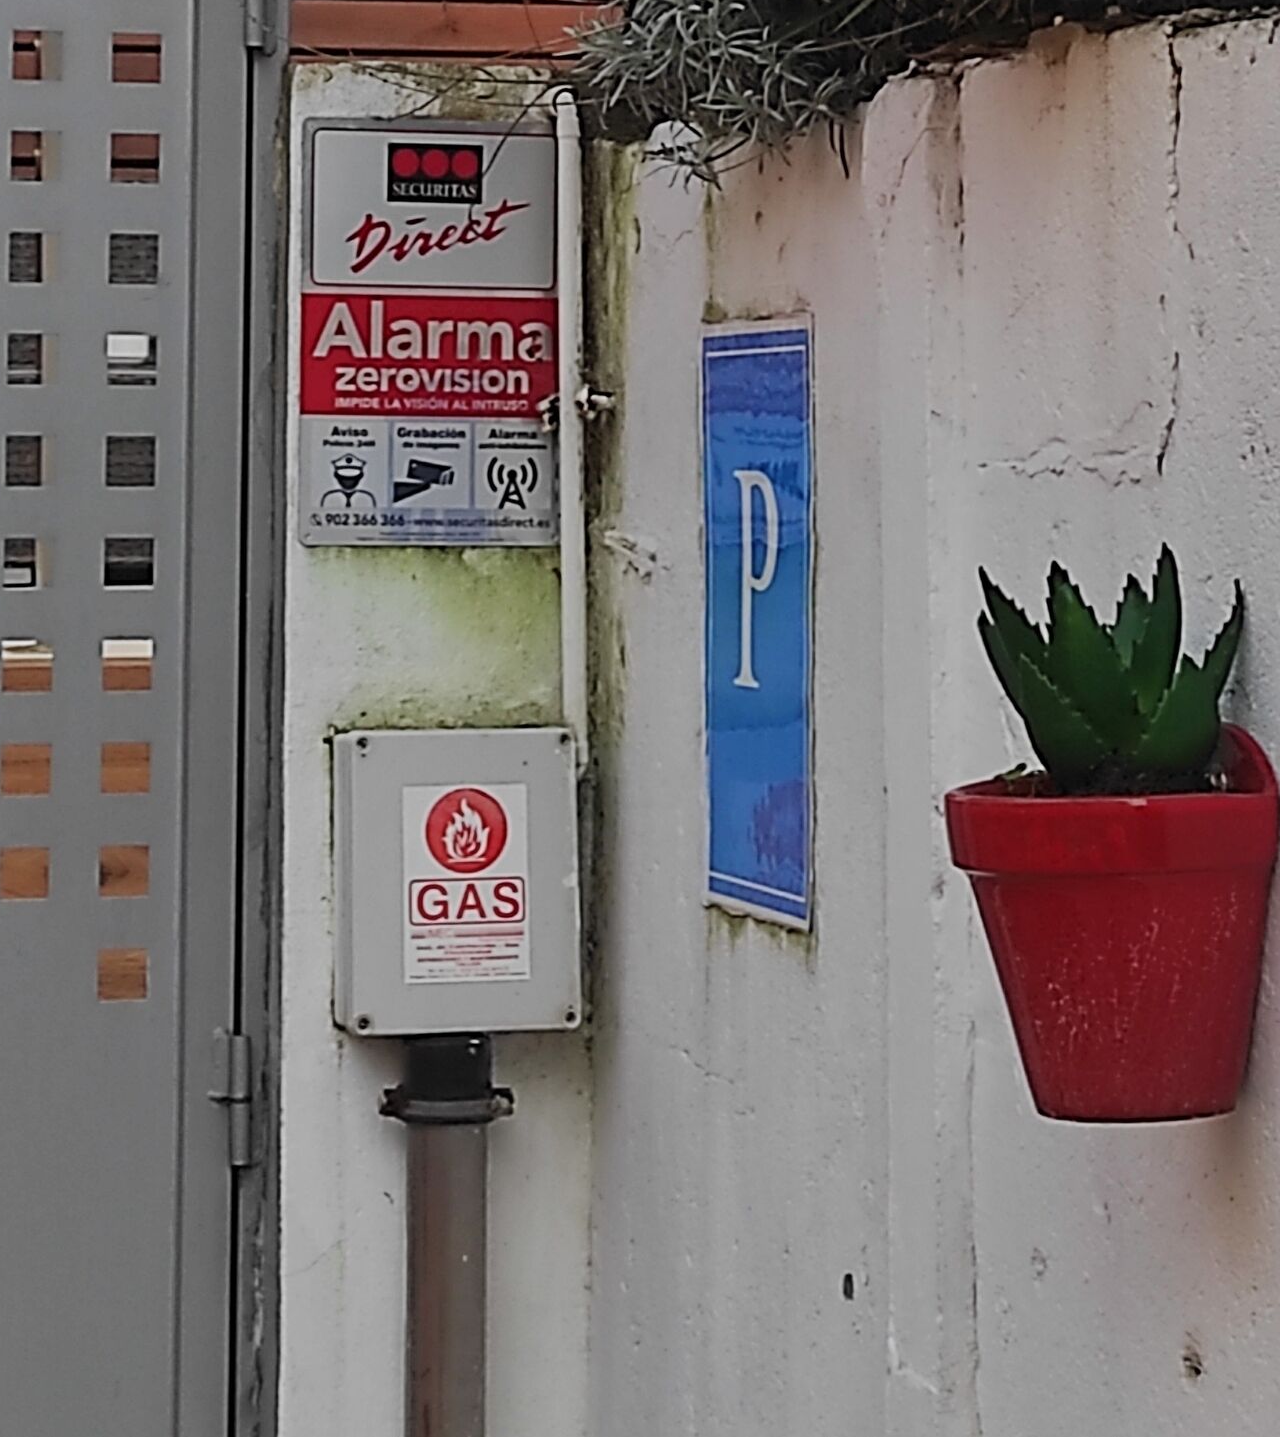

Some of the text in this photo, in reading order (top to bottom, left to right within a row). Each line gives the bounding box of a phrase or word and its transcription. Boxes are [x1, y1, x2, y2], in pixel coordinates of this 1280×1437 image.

[391, 181, 478, 198] SECURITAS
[345, 199, 531, 274] Direct
[312, 299, 553, 363] Alarma
[335, 366, 530, 394] zerovision
[334, 397, 380, 409] IMPIDE
[384, 397, 402, 409] LA
[452, 399, 469, 411] AL
[472, 399, 530, 412] INTRUSO
[396, 426, 467, 440] Grabación
[488, 429, 539, 440] Alarma
[325, 513, 351, 527] 902
[353, 513, 378, 527] 366
[380, 514, 406, 528] 366
[732, 469, 779, 690] P
[416, 880, 521, 921] GAS
